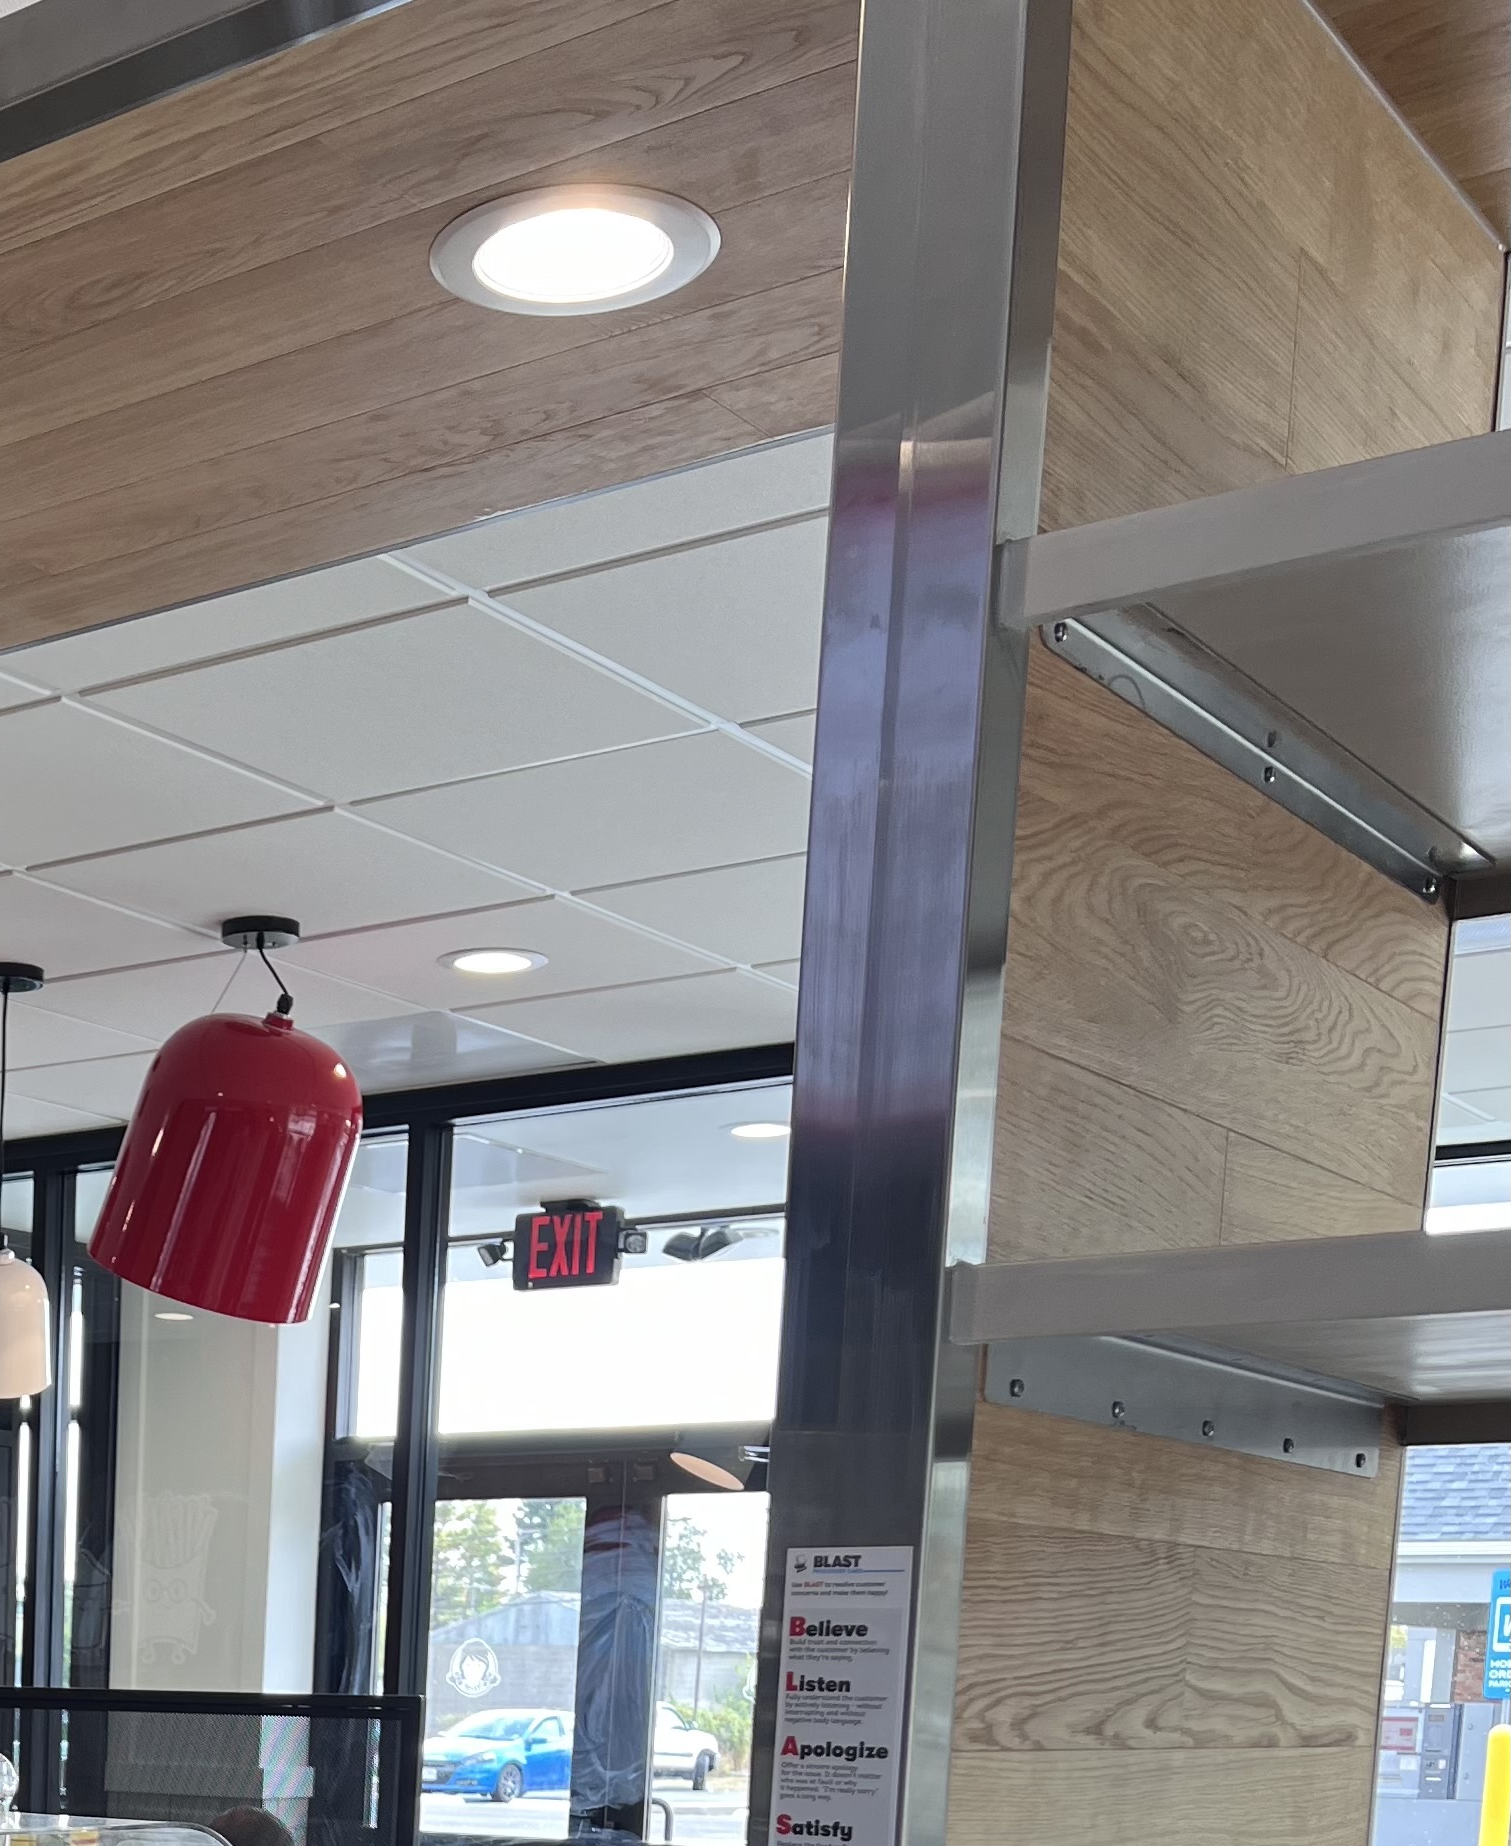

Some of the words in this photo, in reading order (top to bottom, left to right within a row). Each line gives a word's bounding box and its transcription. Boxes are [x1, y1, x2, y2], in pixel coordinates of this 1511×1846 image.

[528, 1210, 603, 1280] EXIT
[812, 1554, 861, 1568] BLAST
[788, 1616, 869, 1636] Believe
[785, 1670, 851, 1692] Listen
[780, 1735, 889, 1762] Apologize
[775, 1813, 853, 1841] Satisfy
